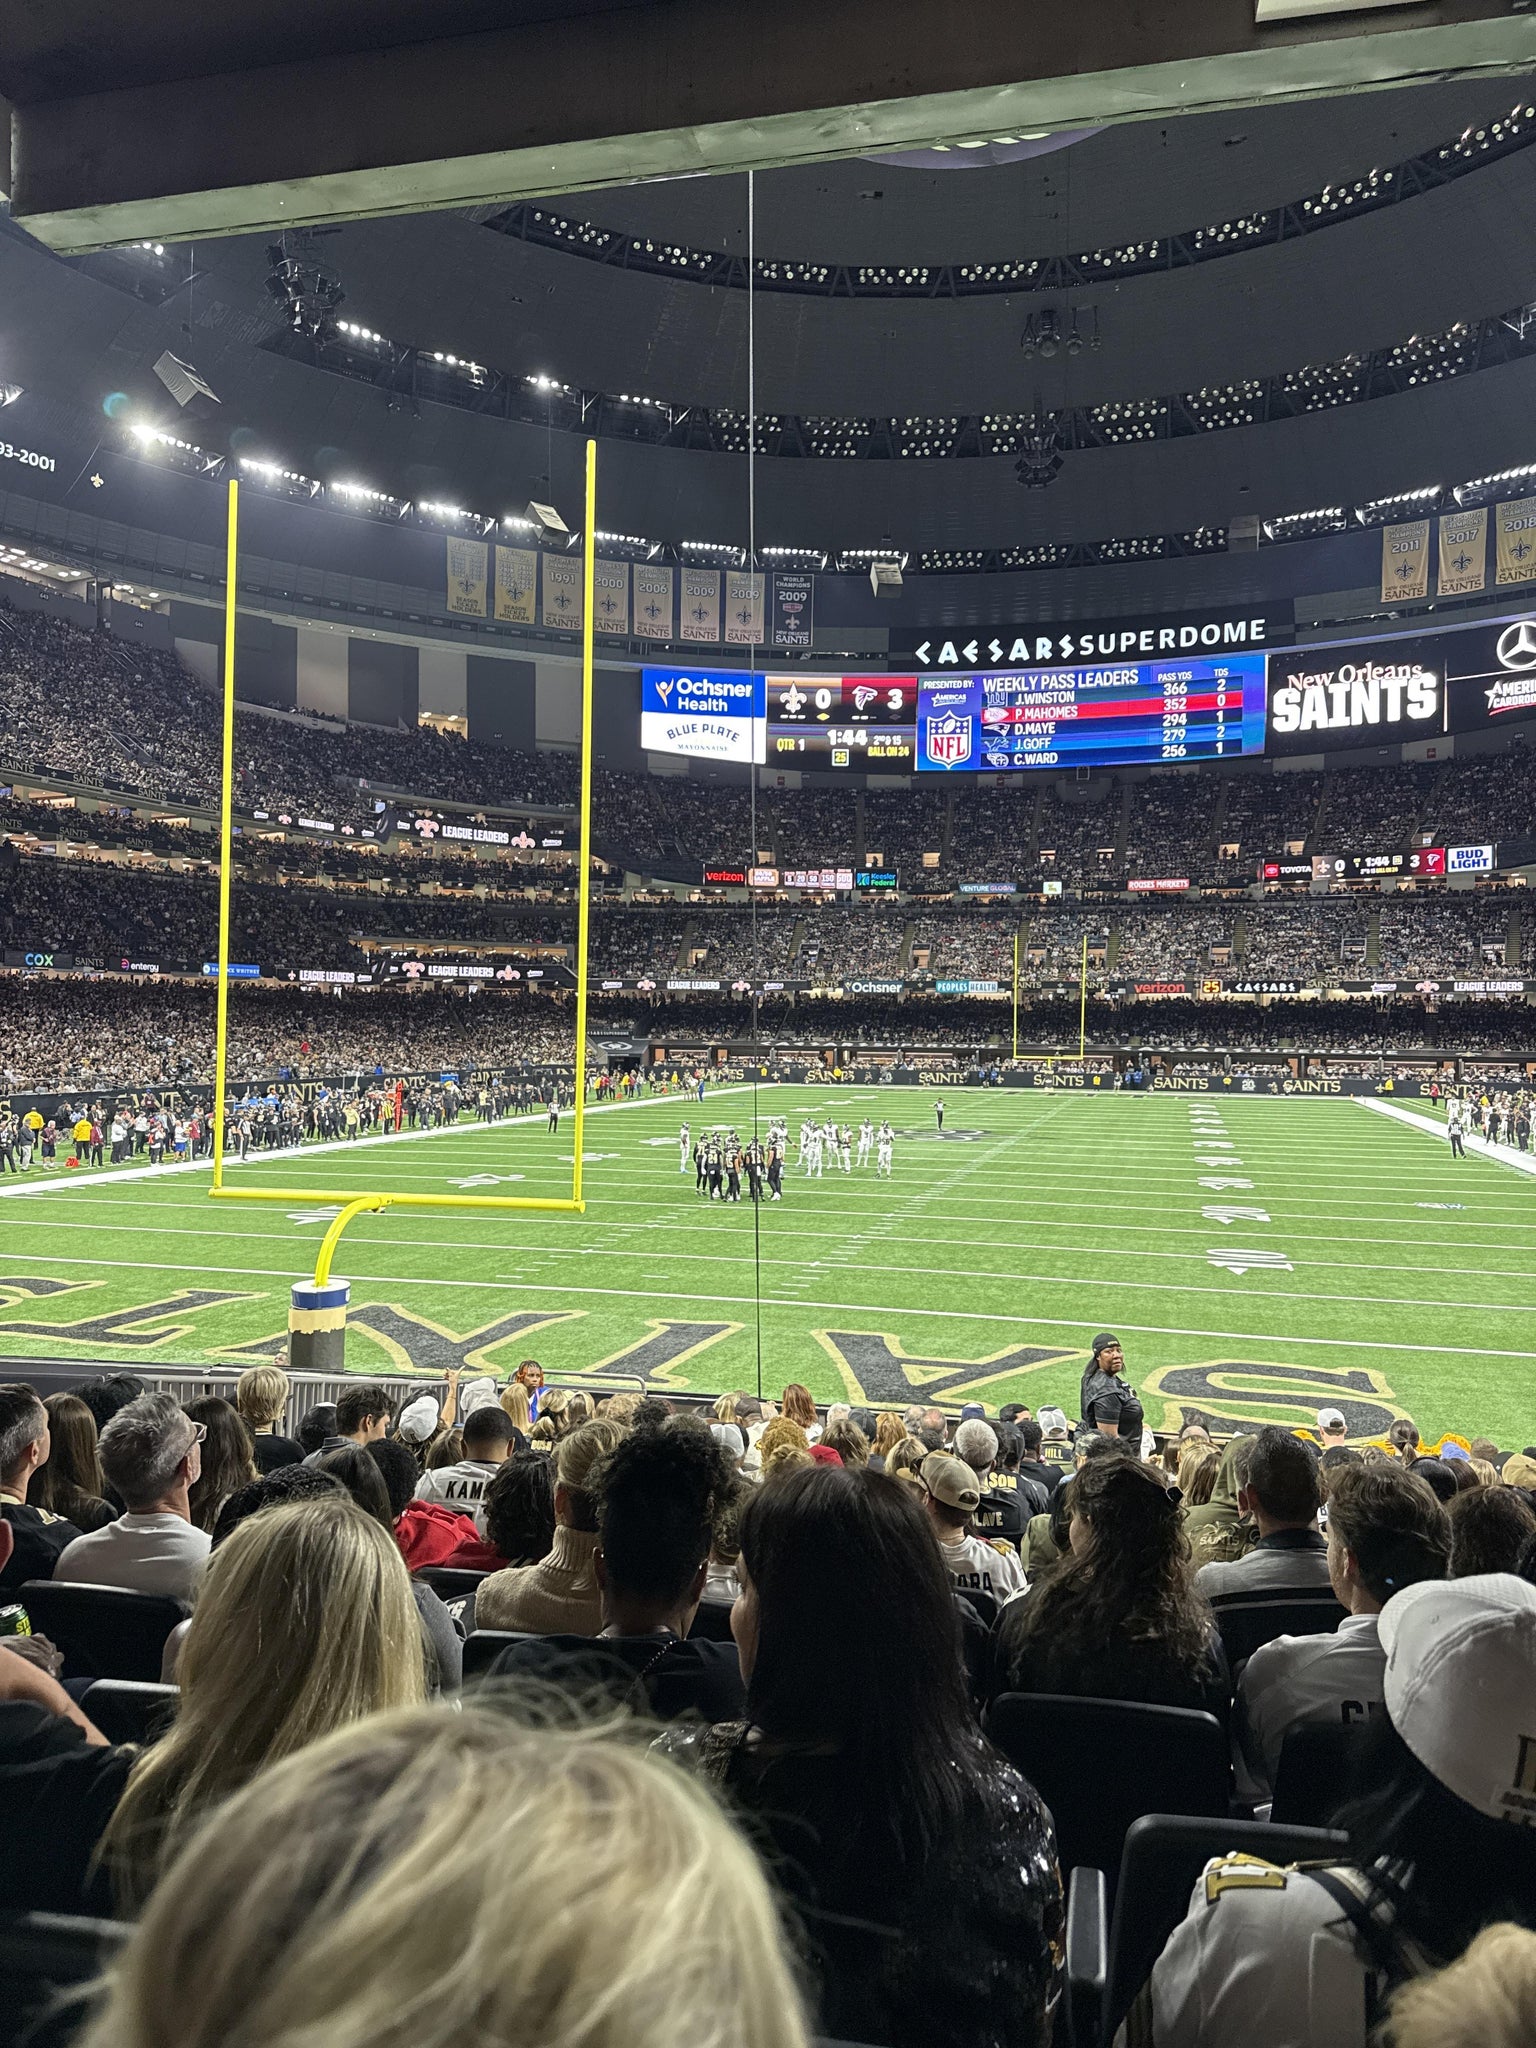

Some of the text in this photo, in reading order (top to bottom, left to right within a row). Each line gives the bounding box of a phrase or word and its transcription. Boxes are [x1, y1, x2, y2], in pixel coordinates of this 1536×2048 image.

[1504, 517, 1536, 533] 2018
[1447, 529, 1479, 545] 2017
[1391, 539, 1420, 554] 2011
[550, 572, 576, 585] 1991
[594, 577, 624, 589] 2000
[638, 583, 668, 594] 2006
[686, 585, 716, 597] 2009
[1441, 579, 1481, 593] SAINTS
[731, 588, 760, 599] 2009
[779, 591, 807, 602] 2009
[1384, 587, 1424, 600] SAINTS
[545, 616, 580, 629] SAINTS
[636, 627, 670, 638] SAINTS
[683, 629, 717, 640] SAINTS
[775, 635, 809, 645] SAINTS
[915, 618, 1267, 666] CAESARS SUPERDOME
[1158, 671, 1192, 682] PASS YDS
[1214, 667, 1229, 677] TDS
[1287, 661, 1424, 693] New Orleans
[676, 677, 753, 697] Ochsner
[923, 679, 975, 689] PRESENTED BY:
[983, 670, 1139, 693] WEEKLY PASS LEADERS
[1216, 679, 1226, 692] 2
[1163, 682, 1188, 696] 366
[678, 697, 728, 712] Health
[815, 688, 832, 710] 0
[887, 688, 903, 710] 3
[1014, 691, 1075, 706] J.WINSTON
[1163, 698, 1187, 711] 352
[1217, 694, 1226, 707] 0
[1272, 672, 1437, 733] SAINTS
[1015, 706, 1078, 720] P.MAHOMES
[1216, 711, 1224, 723] 1
[1162, 713, 1187, 727] 294
[666, 723, 740, 742] BLUE PLATE
[1014, 722, 1056, 735] D.MAYE
[1216, 726, 1225, 738] 2
[827, 729, 868, 746] 1:44
[1162, 729, 1186, 742] 279
[776, 738, 805, 752] QTR 1
[933, 736, 966, 760] NFL
[1015, 738, 1051, 750] J.GOFF
[1216, 742, 1223, 754] 1
[835, 752, 847, 762] 25
[867, 746, 886, 757] BALL
[886, 746, 897, 756] ON
[1161, 744, 1187, 758] 256
[1014, 752, 1058, 765] C.WARD
[1, 758, 35, 774] SAINTS
[73, 774, 105, 788] SAINTS
[138, 788, 167, 801] SAINTS
[200, 799, 223, 811] SAINT
[59, 826, 89, 839] SAINTS
[442, 825, 509, 844] LEAGUE LEADERS
[125, 837, 153, 849] SAINTS
[185, 845, 212, 857] SAINTS
[1456, 849, 1483, 860] BUD
[245, 854, 270, 864] SAINTS
[1410, 855, 1420, 867] 3
[1452, 858, 1489, 869] LIGHT
[1280, 865, 1312, 874] TOYOTA
[1334, 859, 1345, 872] 0
[357, 867, 384, 878] SAINTS
[416, 873, 444, 881] SAINTS
[706, 870, 744, 882] verizon
[477, 877, 505, 885] SAINTS
[536, 880, 564, 888] SAINTS
[1070, 881, 1098, 889] SAINTS
[1199, 878, 1228, 886] SAINTS
[25, 953, 54, 966] COX
[75, 957, 104, 967] SAINTS
[130, 962, 160, 973] entergy
[428, 965, 494, 977] LEAGUE LEADERS
[300, 970, 326, 982] LEAGUE
[326, 971, 355, 983] LEADERS
[810, 980, 839, 988] SAINTS
[852, 982, 902, 993] Ochsner
[937, 982, 998, 992] PEOPLES HEALTH
[1012, 981, 1042, 989] AINTS
[1134, 981, 1186, 993] verizon
[1203, 981, 1220, 993] 25
[1235, 982, 1296, 993] CAESARS
[1305, 981, 1340, 989] SAINTS
[1454, 981, 1524, 992] LEAGUE LEADERS
[1154, 1078, 1209, 1090] SAINTS
[1283, 1080, 1341, 1092] SAINTS
[1044, 1448, 1063, 1459] HILL
[446, 1480, 484, 1500] KAM
[957, 1572, 994, 1593] ARA
